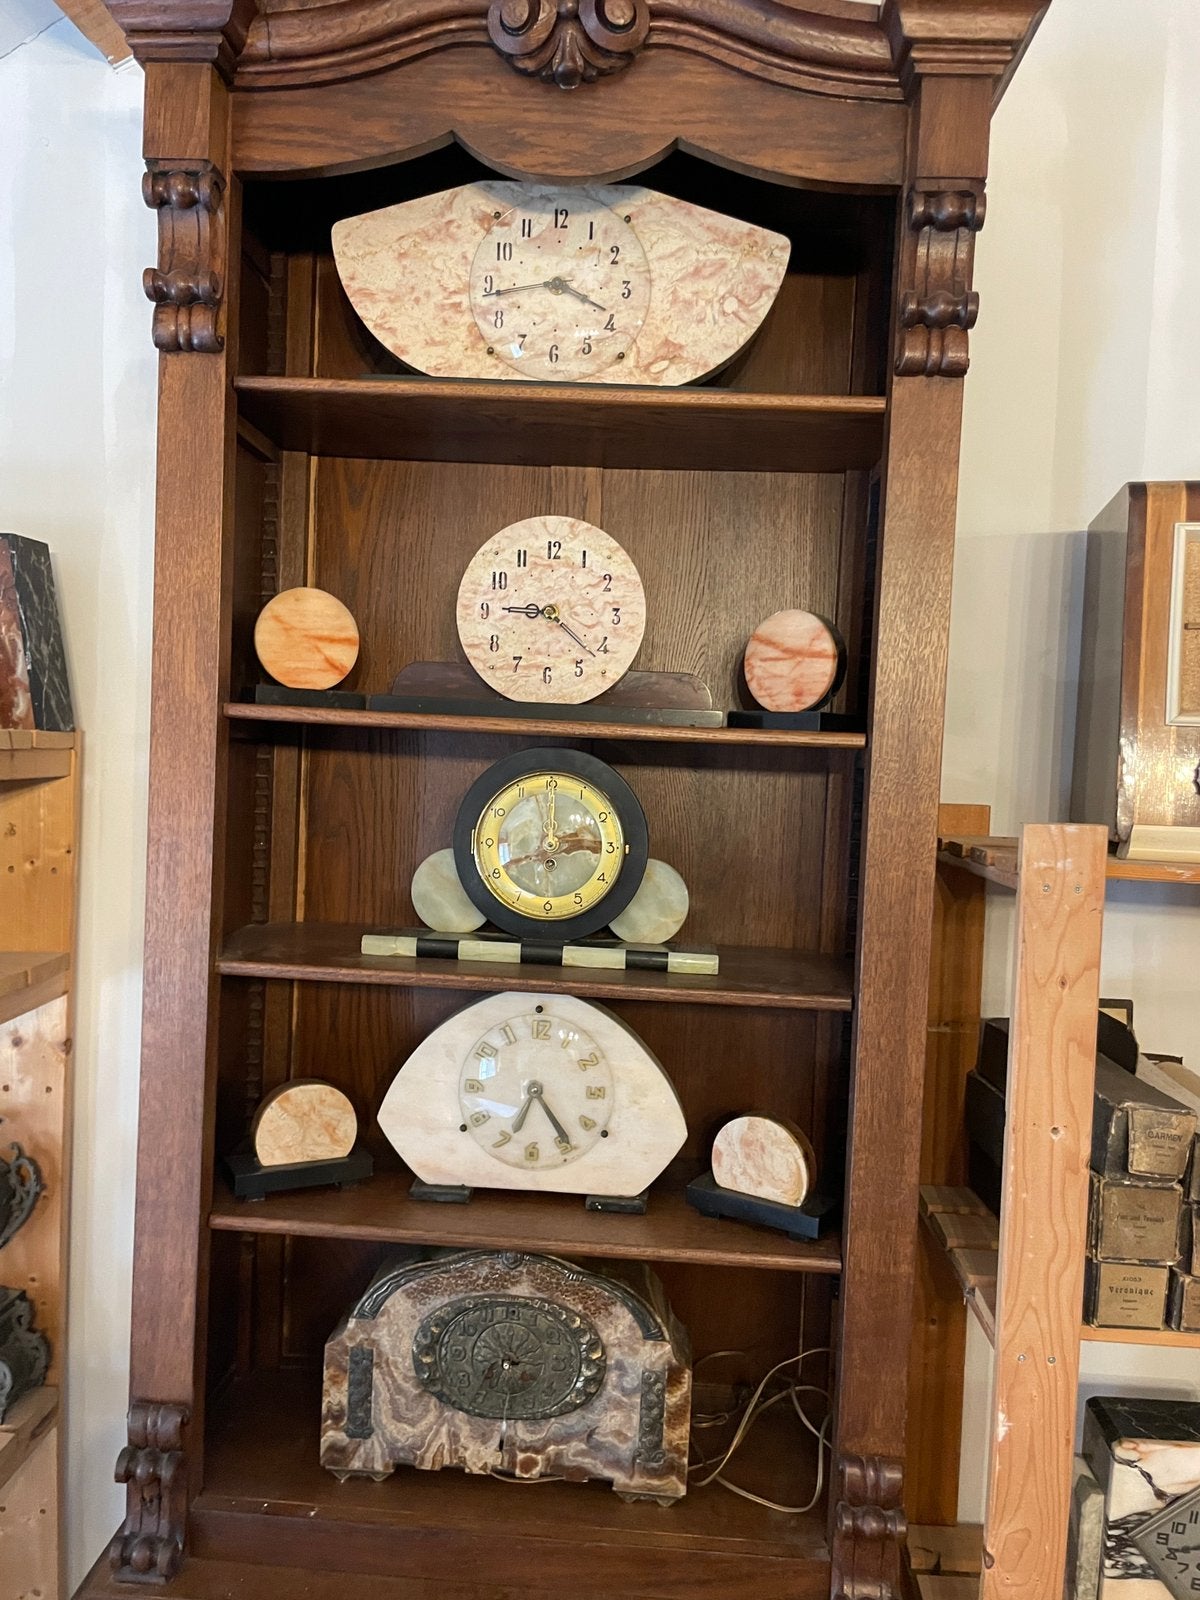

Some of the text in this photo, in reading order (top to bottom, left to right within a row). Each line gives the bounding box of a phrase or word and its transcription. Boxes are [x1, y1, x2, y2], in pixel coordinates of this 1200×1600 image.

[554, 209, 569, 228] 12
[522, 219, 531, 237] 11
[589, 221, 594, 240] 1
[497, 242, 512, 261] 10
[610, 246, 620, 265] 2
[484, 275, 493, 293] 9
[622, 281, 631, 299] 3
[494, 311, 503, 328] 8
[603, 314, 616, 332] 4
[518, 334, 527, 349] 7
[582, 336, 592, 354] 5
[549, 345, 558, 363] 6
[517, 550, 526, 567] 11
[548, 541, 561, 559] 12
[582, 550, 587, 568] 1
[492, 571, 507, 590] 10
[603, 574, 612, 592] 2
[481, 602, 489, 619] 9
[612, 608, 620, 625] 3
[490, 635, 499, 652] 8
[597, 637, 609, 654] 4
[513, 656, 522, 672] 7
[575, 659, 584, 677] 5
[543, 666, 552, 684] 6
[518, 787, 524, 798] 11
[580, 789, 583, 800] 1
[494, 808, 505, 818] 10
[598, 812, 607, 824] 2
[485, 838, 494, 849] 9
[606, 842, 615, 853] 3
[492, 868, 500, 879] 8
[597, 872, 606, 882] 4
[515, 891, 522, 902] 7
[574, 893, 582, 904] 5
[543, 901, 552, 912] 6
[500, 1023, 517, 1046] 11
[532, 1020, 551, 1040] 12
[474, 1041, 498, 1061] 10
[578, 1052, 599, 1071] 2
[465, 1079, 484, 1093] 9
[586, 1086, 605, 1099] 3
[470, 1110, 491, 1127] 8
[579, 1115, 596, 1131] 4
[492, 1130, 512, 1148] 7
[1147, 1130, 1183, 1142] CARMEN
[525, 1142, 539, 1161] 6
[555, 1136, 574, 1155] 5
[1108, 1285, 1154, 1296] Veronique
[1189, 1511, 1198, 1524] 11
[1171, 1522, 1186, 1534] 10
[1156, 1532, 1169, 1545] 9
[1177, 1562, 1189, 1573] 7
